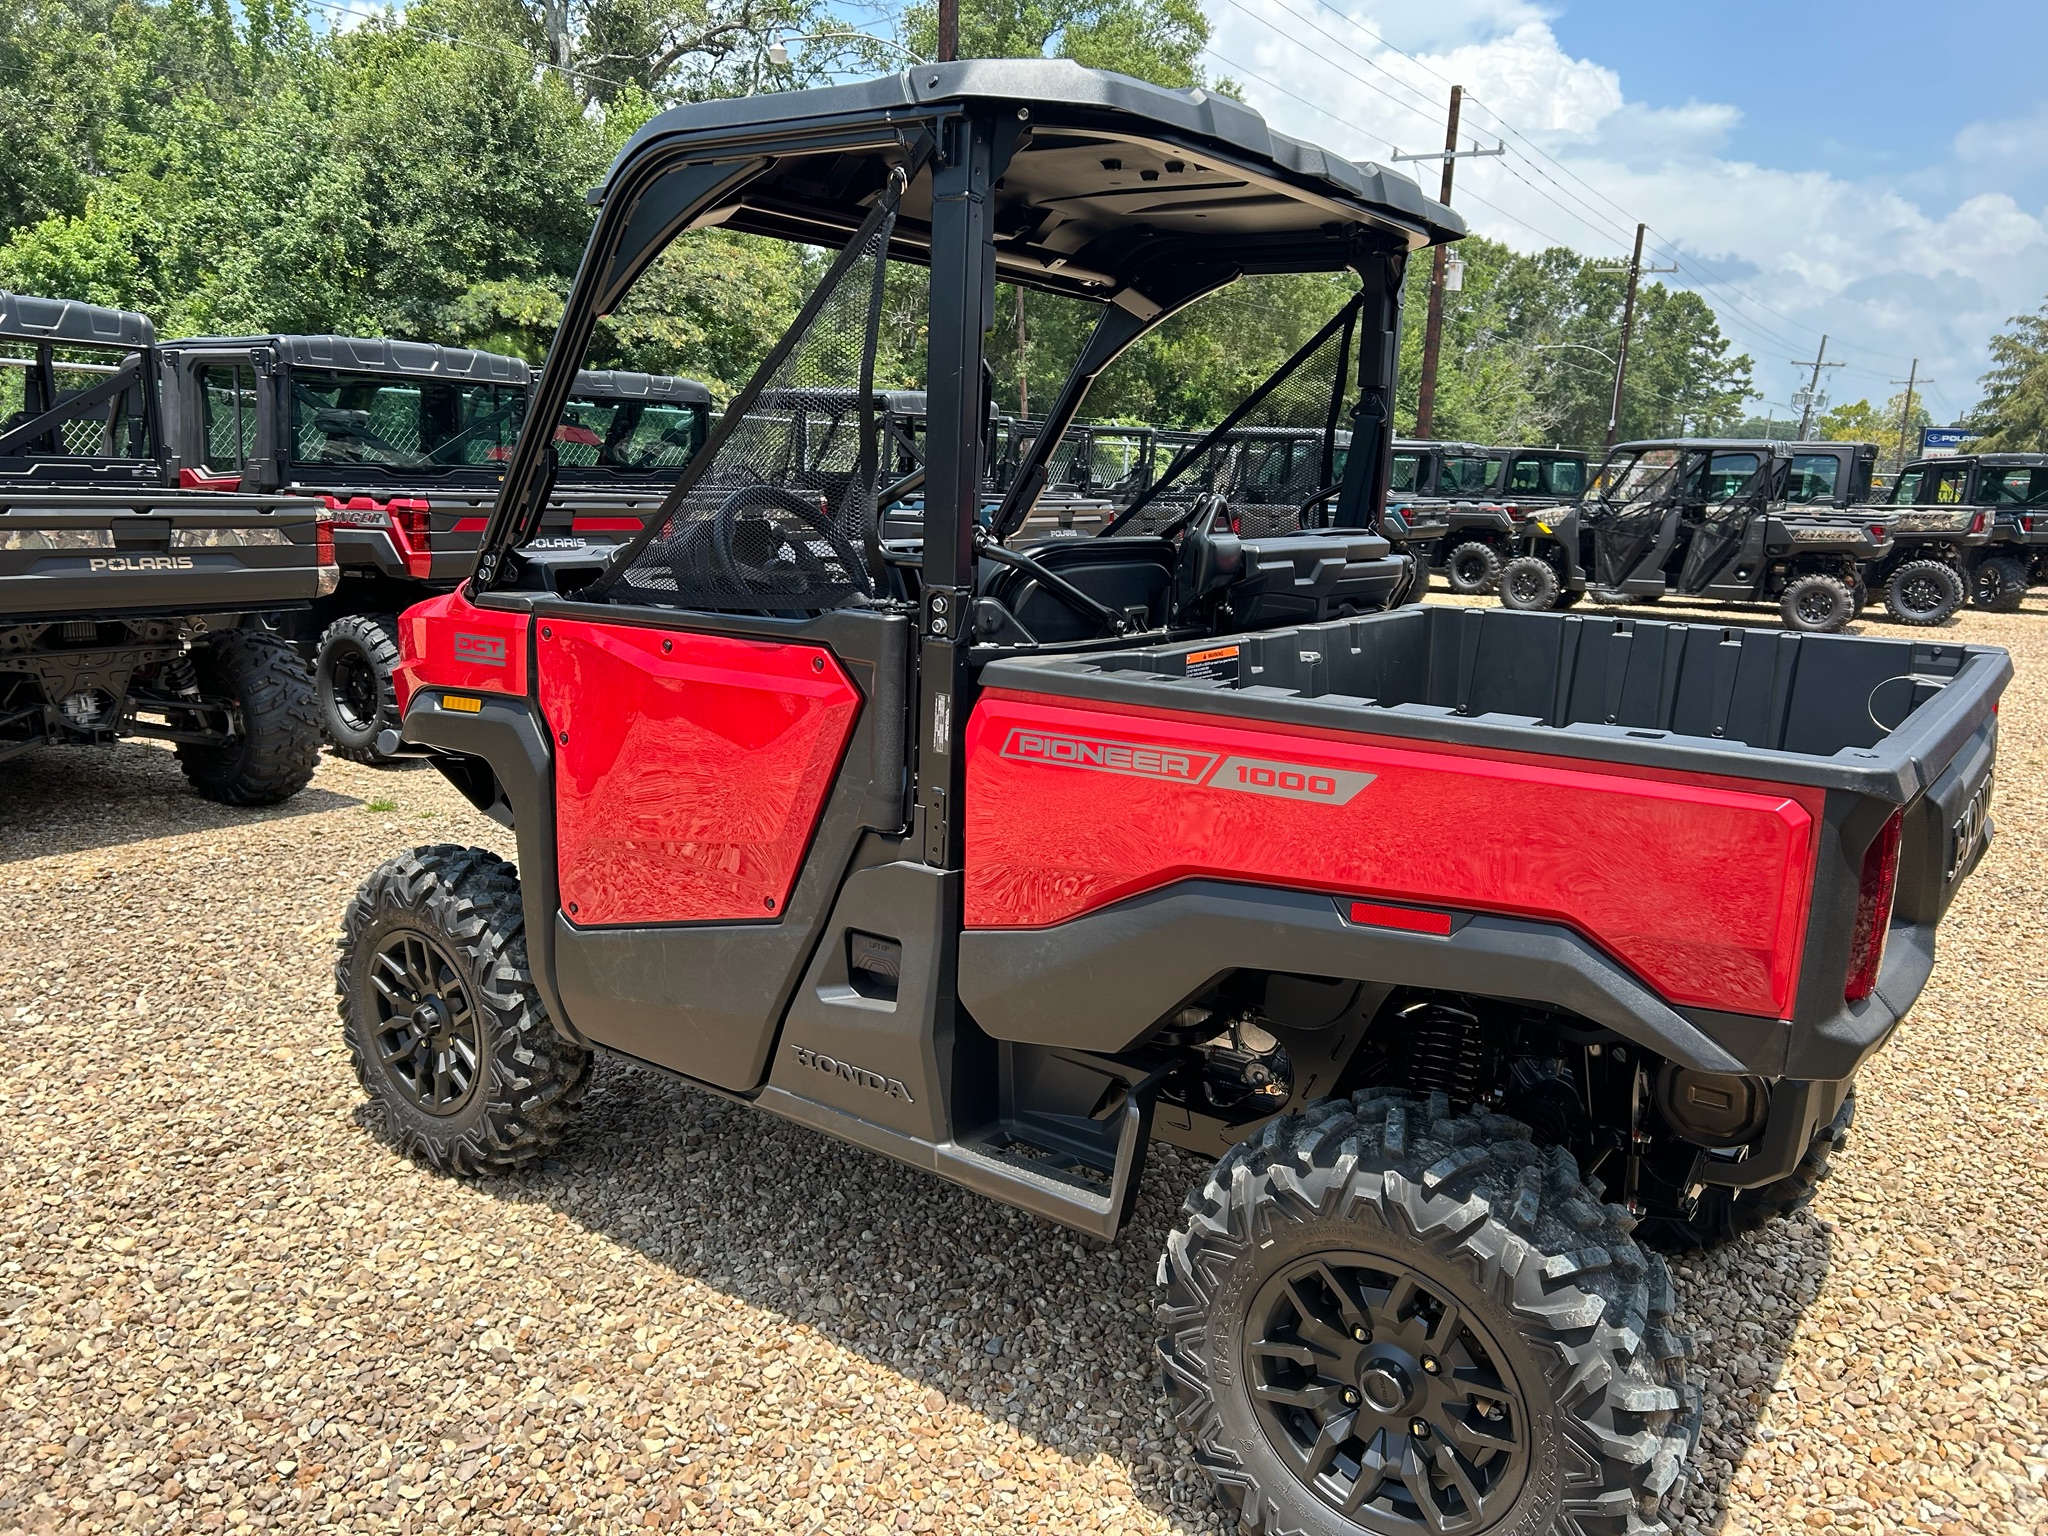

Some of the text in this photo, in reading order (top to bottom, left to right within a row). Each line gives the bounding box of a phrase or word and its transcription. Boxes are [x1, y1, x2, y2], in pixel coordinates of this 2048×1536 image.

[331, 512, 383, 523] ANGER
[526, 538, 587, 548] POLARIS
[89, 556, 194, 572] POLARIS
[457, 637, 503, 655] DCT
[1019, 735, 1337, 796] PIONEER 1000
[1946, 763, 1994, 884] HOND
[870, 941, 881, 950] LIFT
[791, 1044, 915, 1104] HONDA
